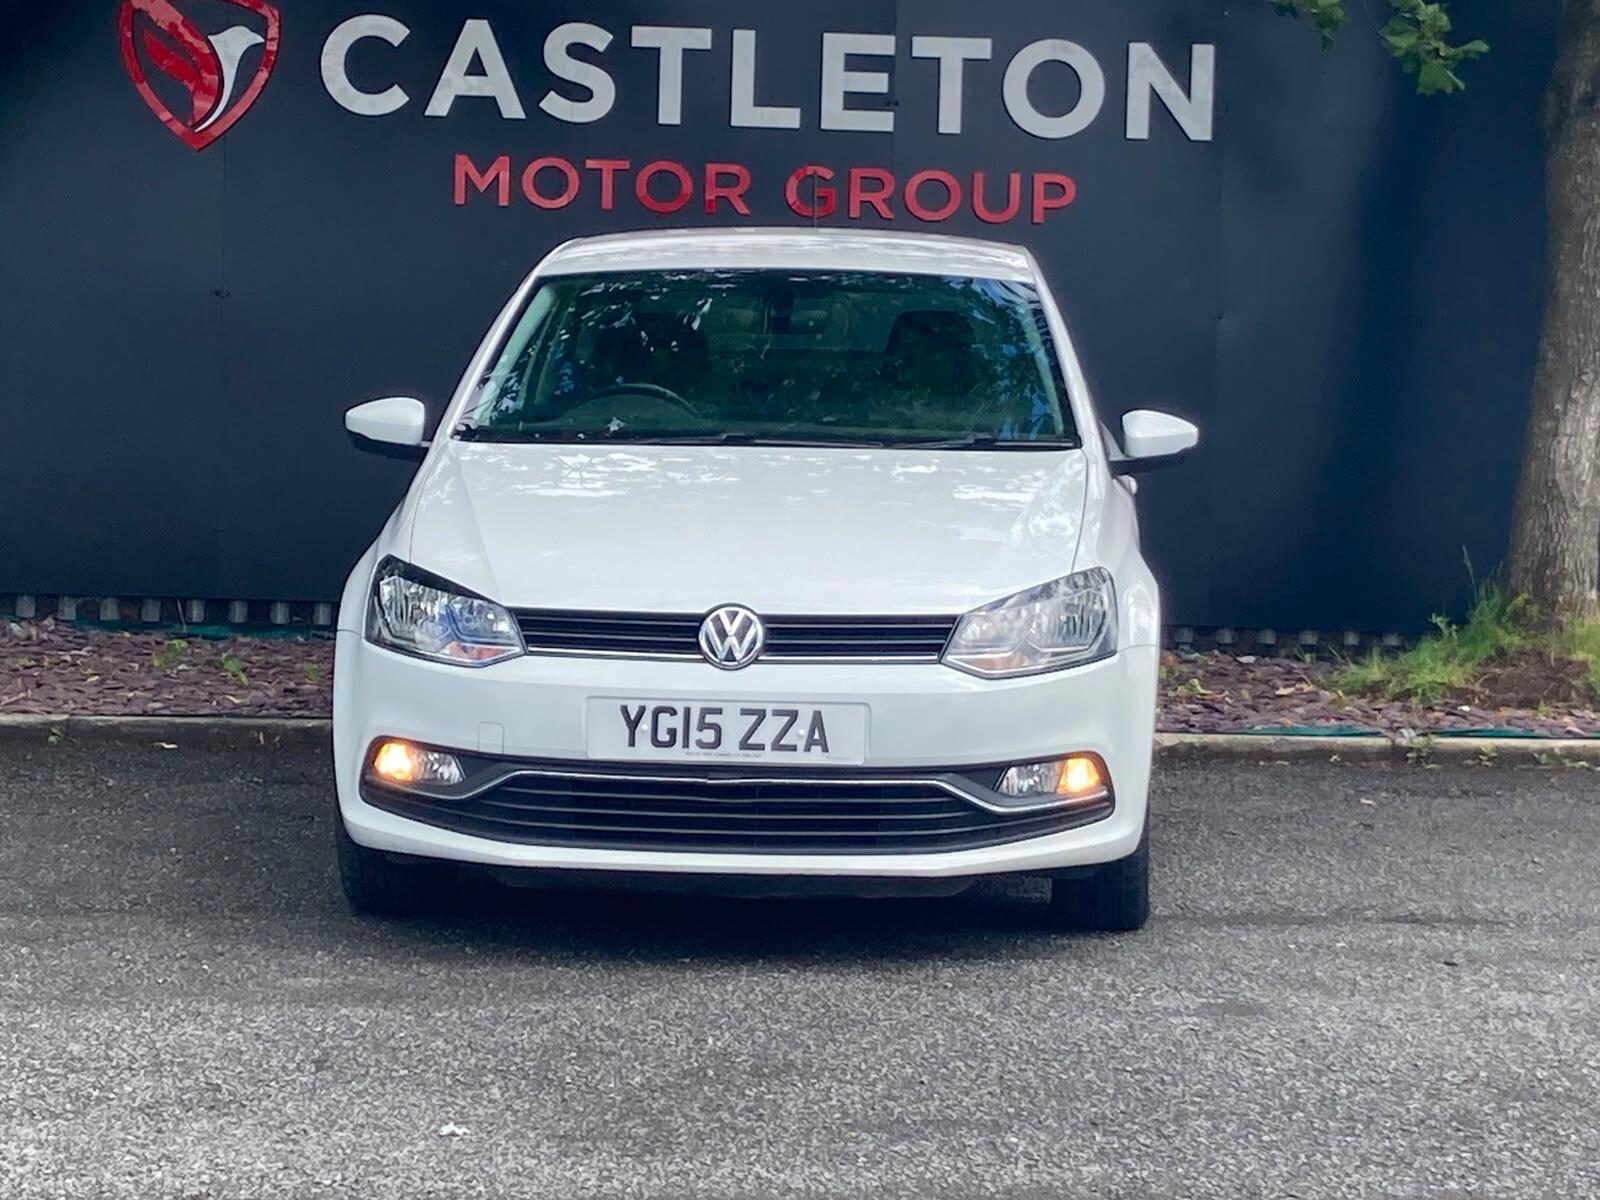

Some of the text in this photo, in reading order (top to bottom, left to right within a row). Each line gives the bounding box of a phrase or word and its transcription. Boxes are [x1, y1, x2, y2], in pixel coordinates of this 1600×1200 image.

[320, 14, 1216, 142] CASTLETON
[452, 153, 1077, 225] MOTOR GROUP
[620, 704, 830, 753] YG15 ZZA
